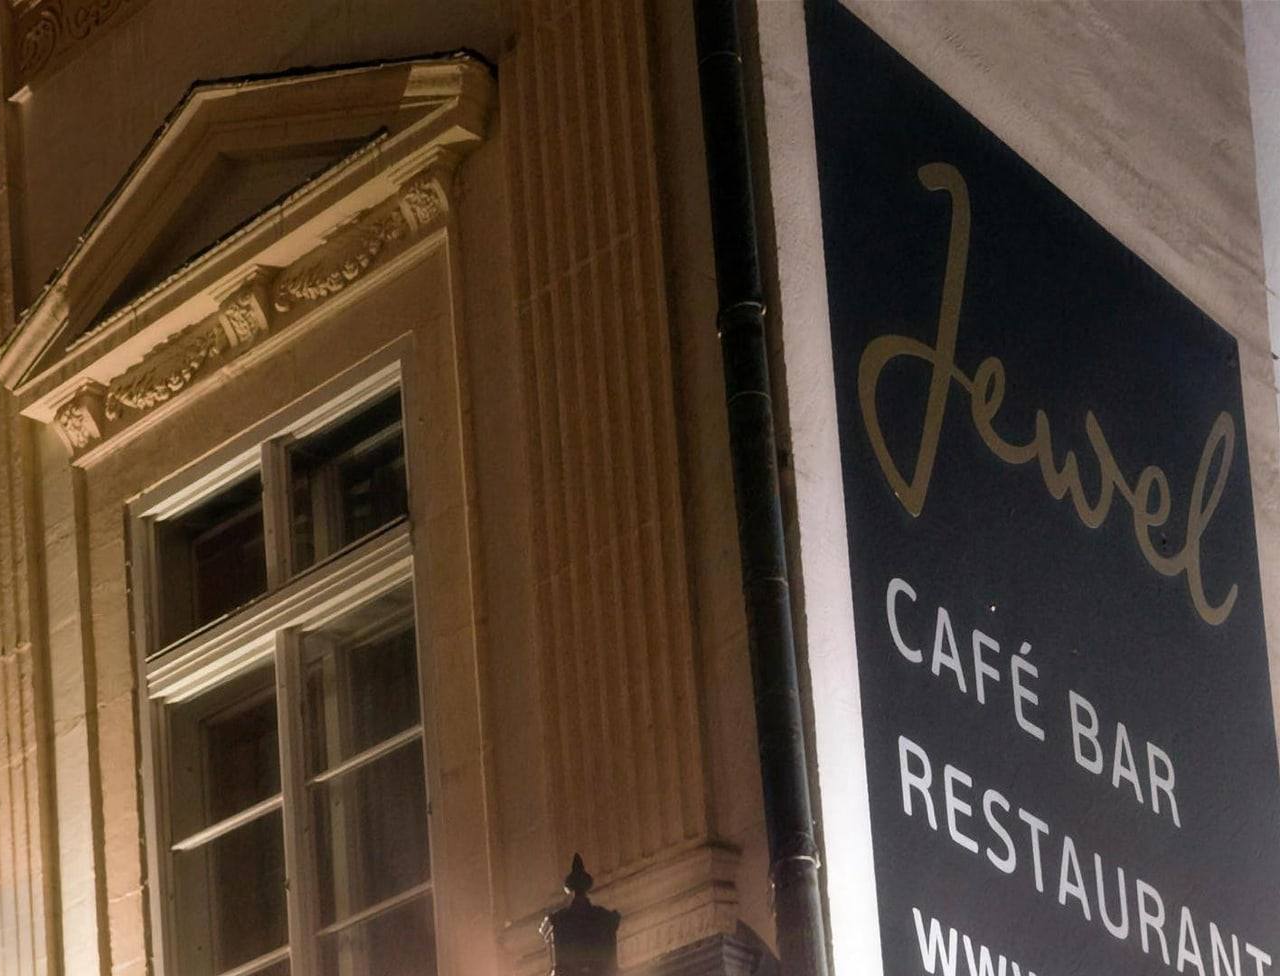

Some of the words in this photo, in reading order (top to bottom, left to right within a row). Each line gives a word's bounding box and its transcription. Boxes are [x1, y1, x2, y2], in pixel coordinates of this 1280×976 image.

[858, 162, 1238, 625] Jewel
[886, 578, 1045, 740] CAFÉ
[1069, 690, 1181, 827] BAR
